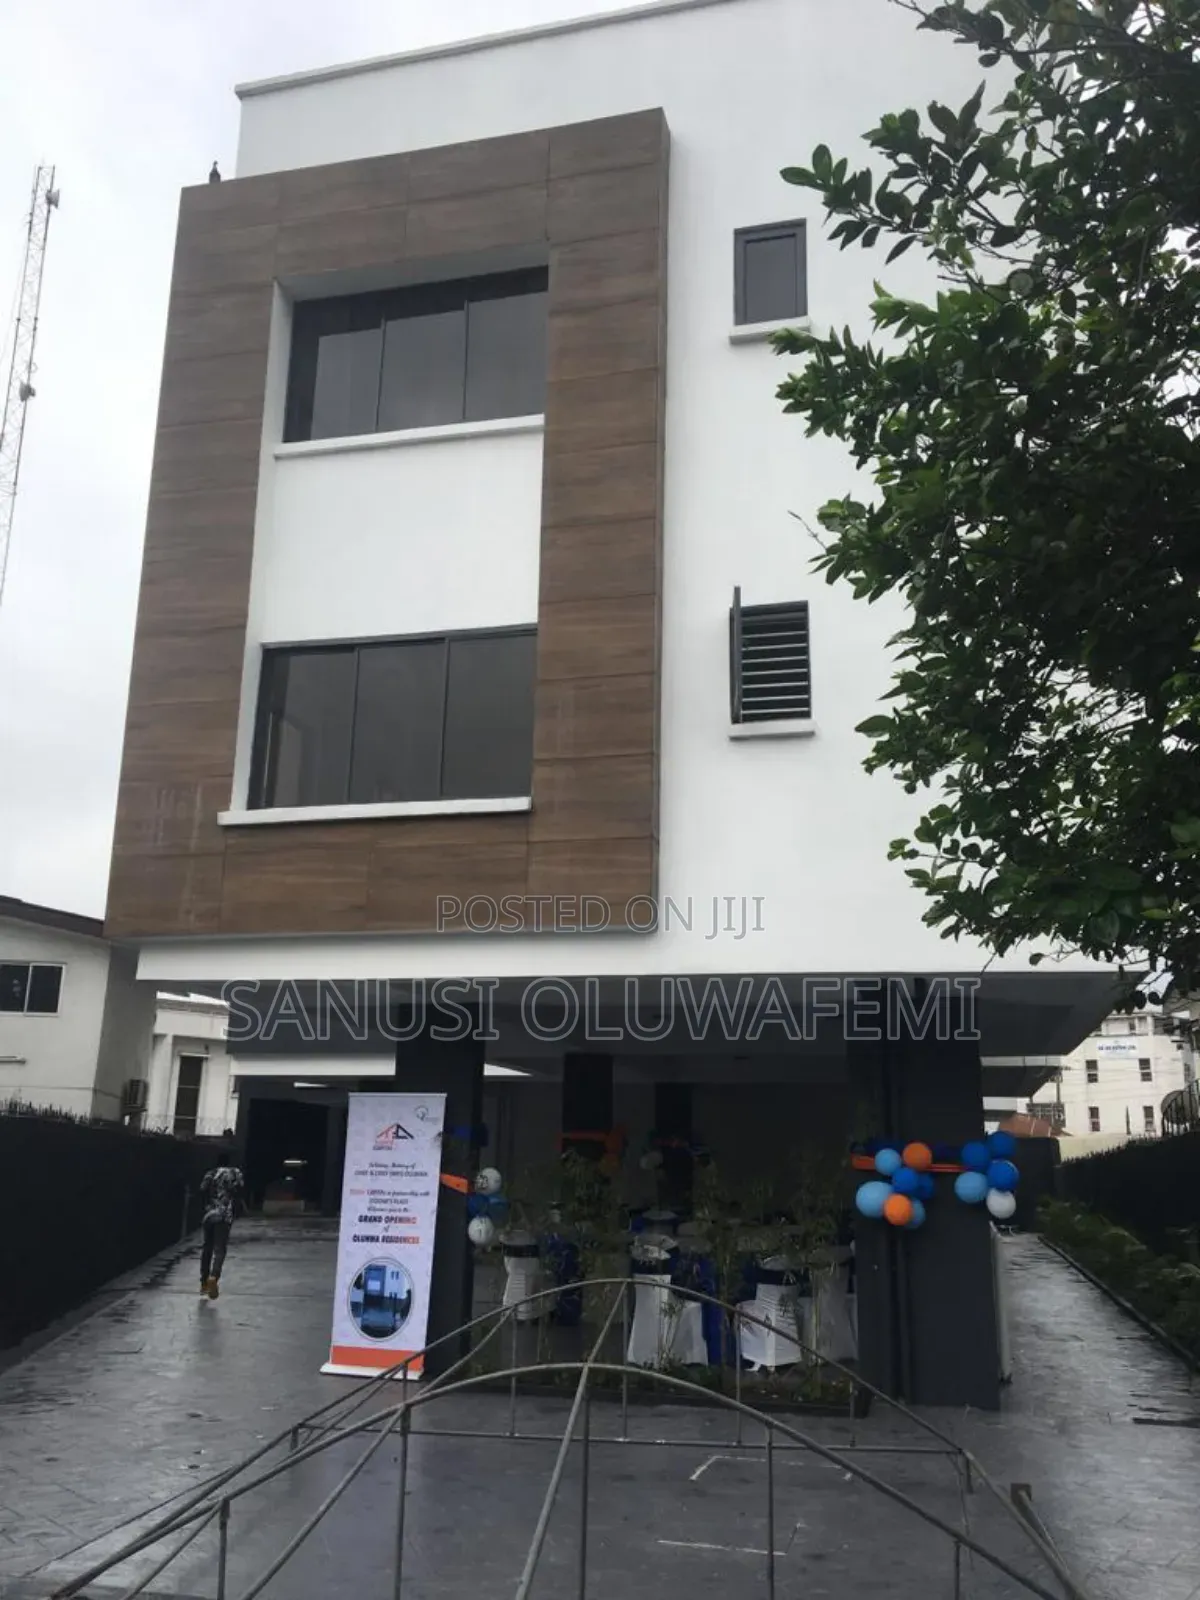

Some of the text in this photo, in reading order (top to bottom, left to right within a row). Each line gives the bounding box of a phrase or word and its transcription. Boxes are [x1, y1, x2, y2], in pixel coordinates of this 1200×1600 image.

[358, 1215, 417, 1224] GRAND OPENING
[381, 1235, 420, 1244] RESIDENCES
